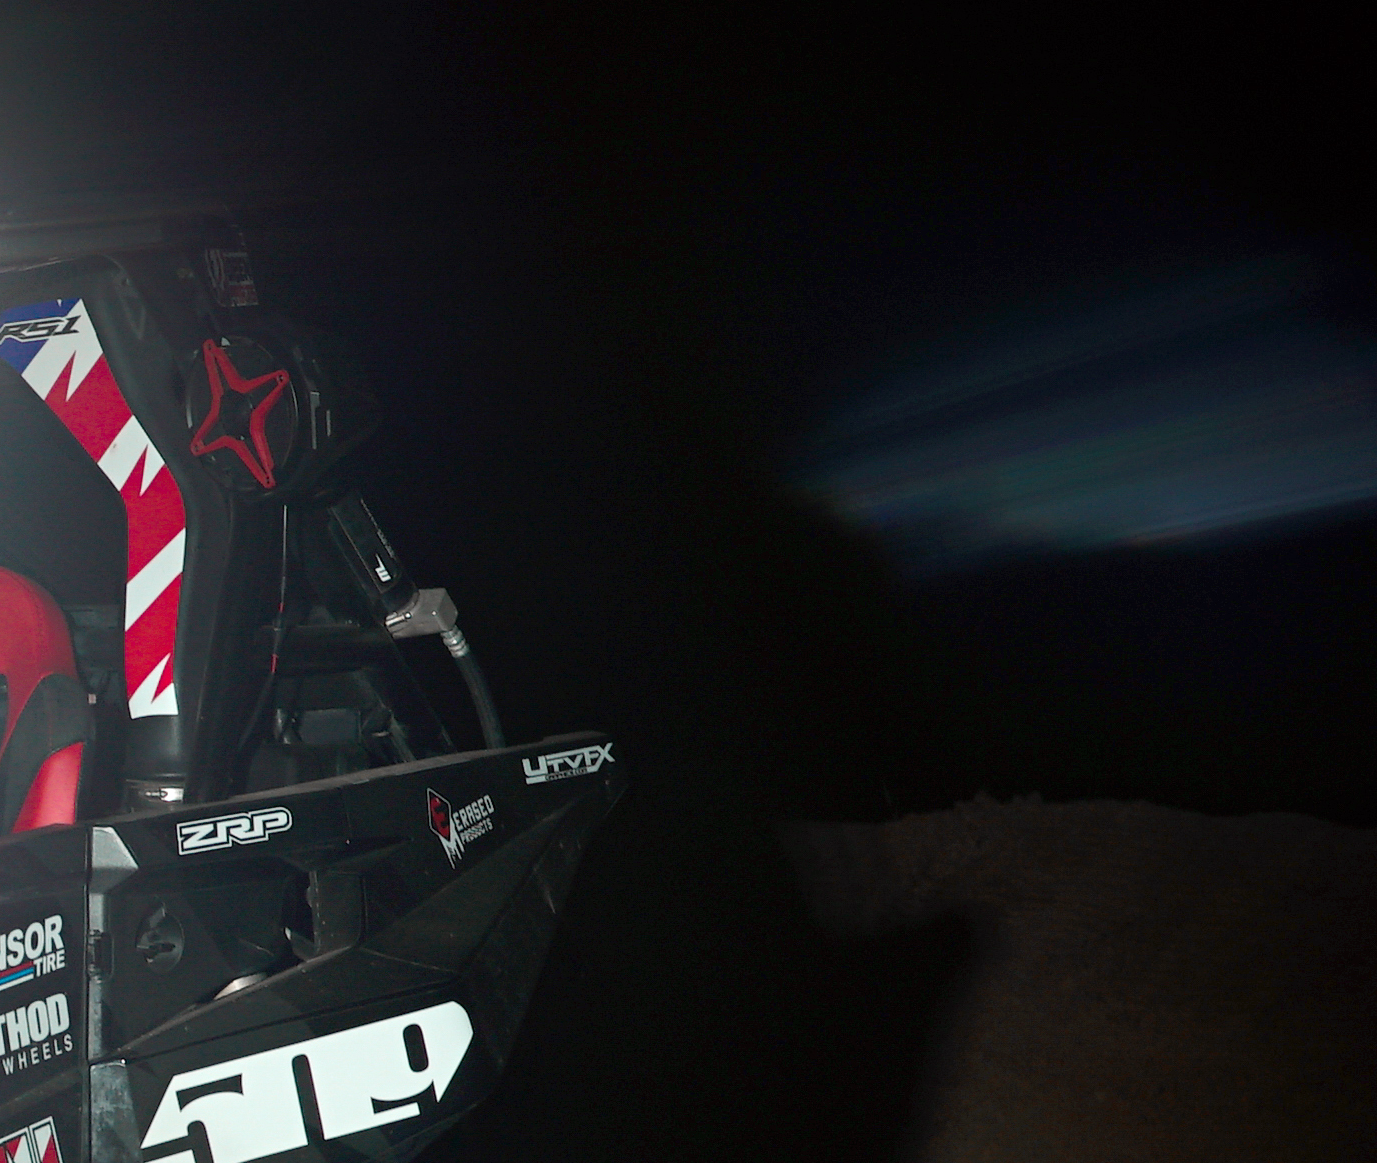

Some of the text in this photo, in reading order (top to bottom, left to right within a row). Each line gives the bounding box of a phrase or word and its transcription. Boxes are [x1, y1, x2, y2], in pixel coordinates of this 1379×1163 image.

[177, 807, 293, 855] ZRP
[33, 949, 66, 977] TIRE
[2, 1033, 73, 1075] WHEELS
